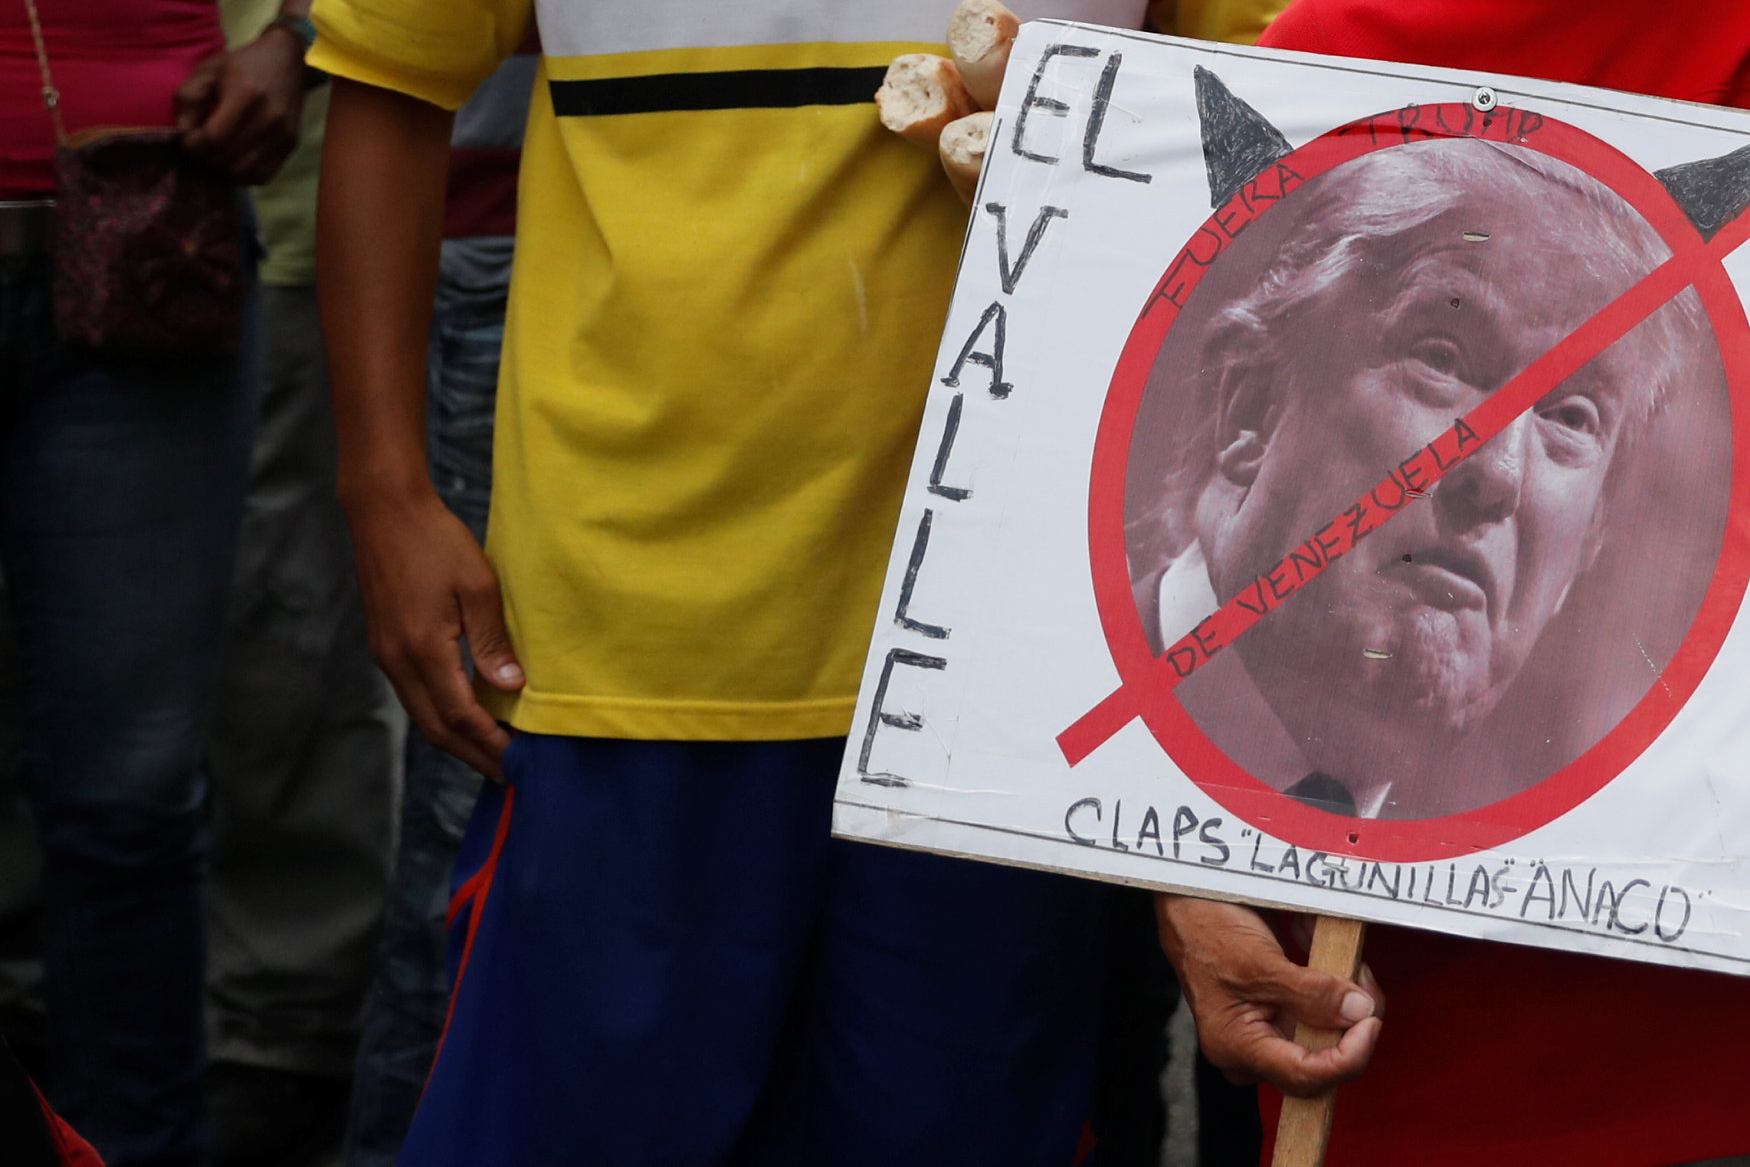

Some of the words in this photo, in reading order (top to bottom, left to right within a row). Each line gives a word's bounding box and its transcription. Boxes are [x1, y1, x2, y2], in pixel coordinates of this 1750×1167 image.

[1010, 42, 1153, 184] EL
[1141, 163, 1306, 320] FUERA
[858, 200, 1069, 789] VALLE
[1166, 615, 1223, 677] DE
[1237, 417, 1480, 615] VENEZUELA
[1064, 797, 1231, 866] CLAPS
